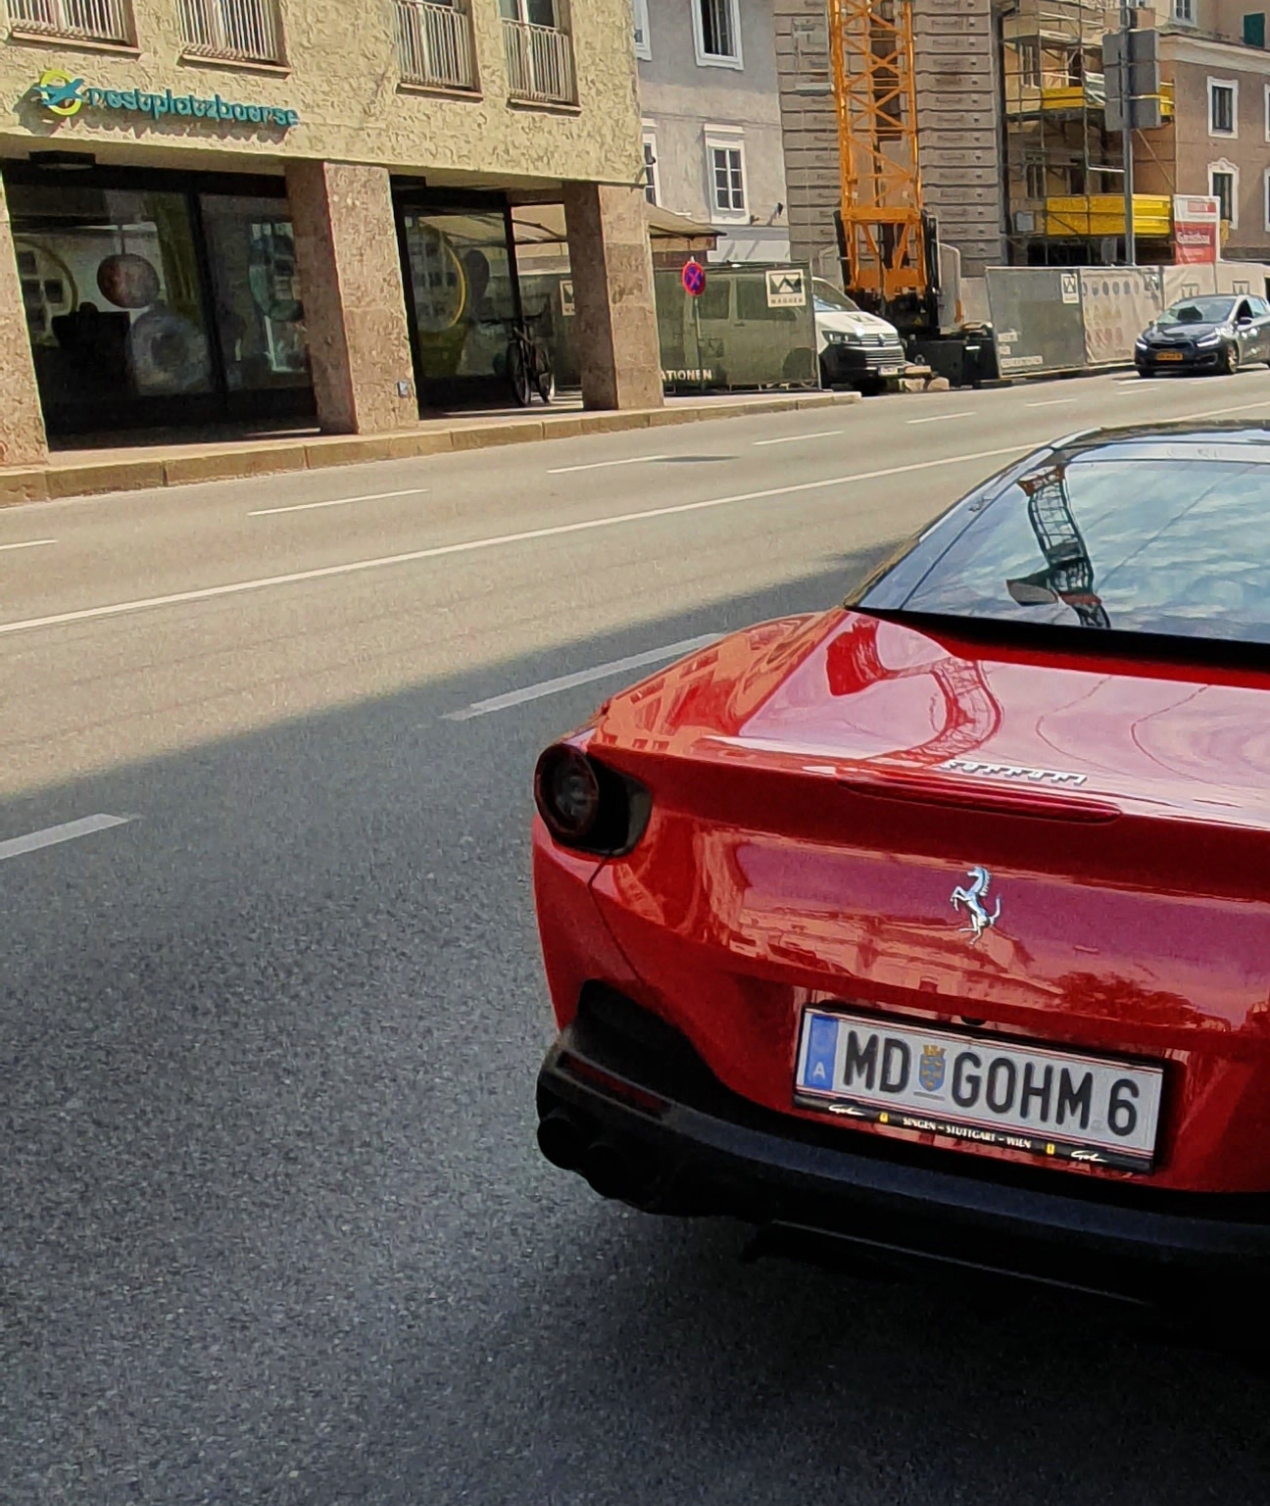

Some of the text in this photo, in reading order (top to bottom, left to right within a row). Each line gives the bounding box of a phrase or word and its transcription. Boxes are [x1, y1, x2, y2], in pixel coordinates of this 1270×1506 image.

[87, 88, 299, 127] restplatzboerse
[812, 1030, 1140, 1137] A MD GOHM 6
[903, 1117, 936, 1131] SINGEN
[946, 1125, 995, 1142] STUTTGART
[1006, 1137, 1032, 1149] WIEN
